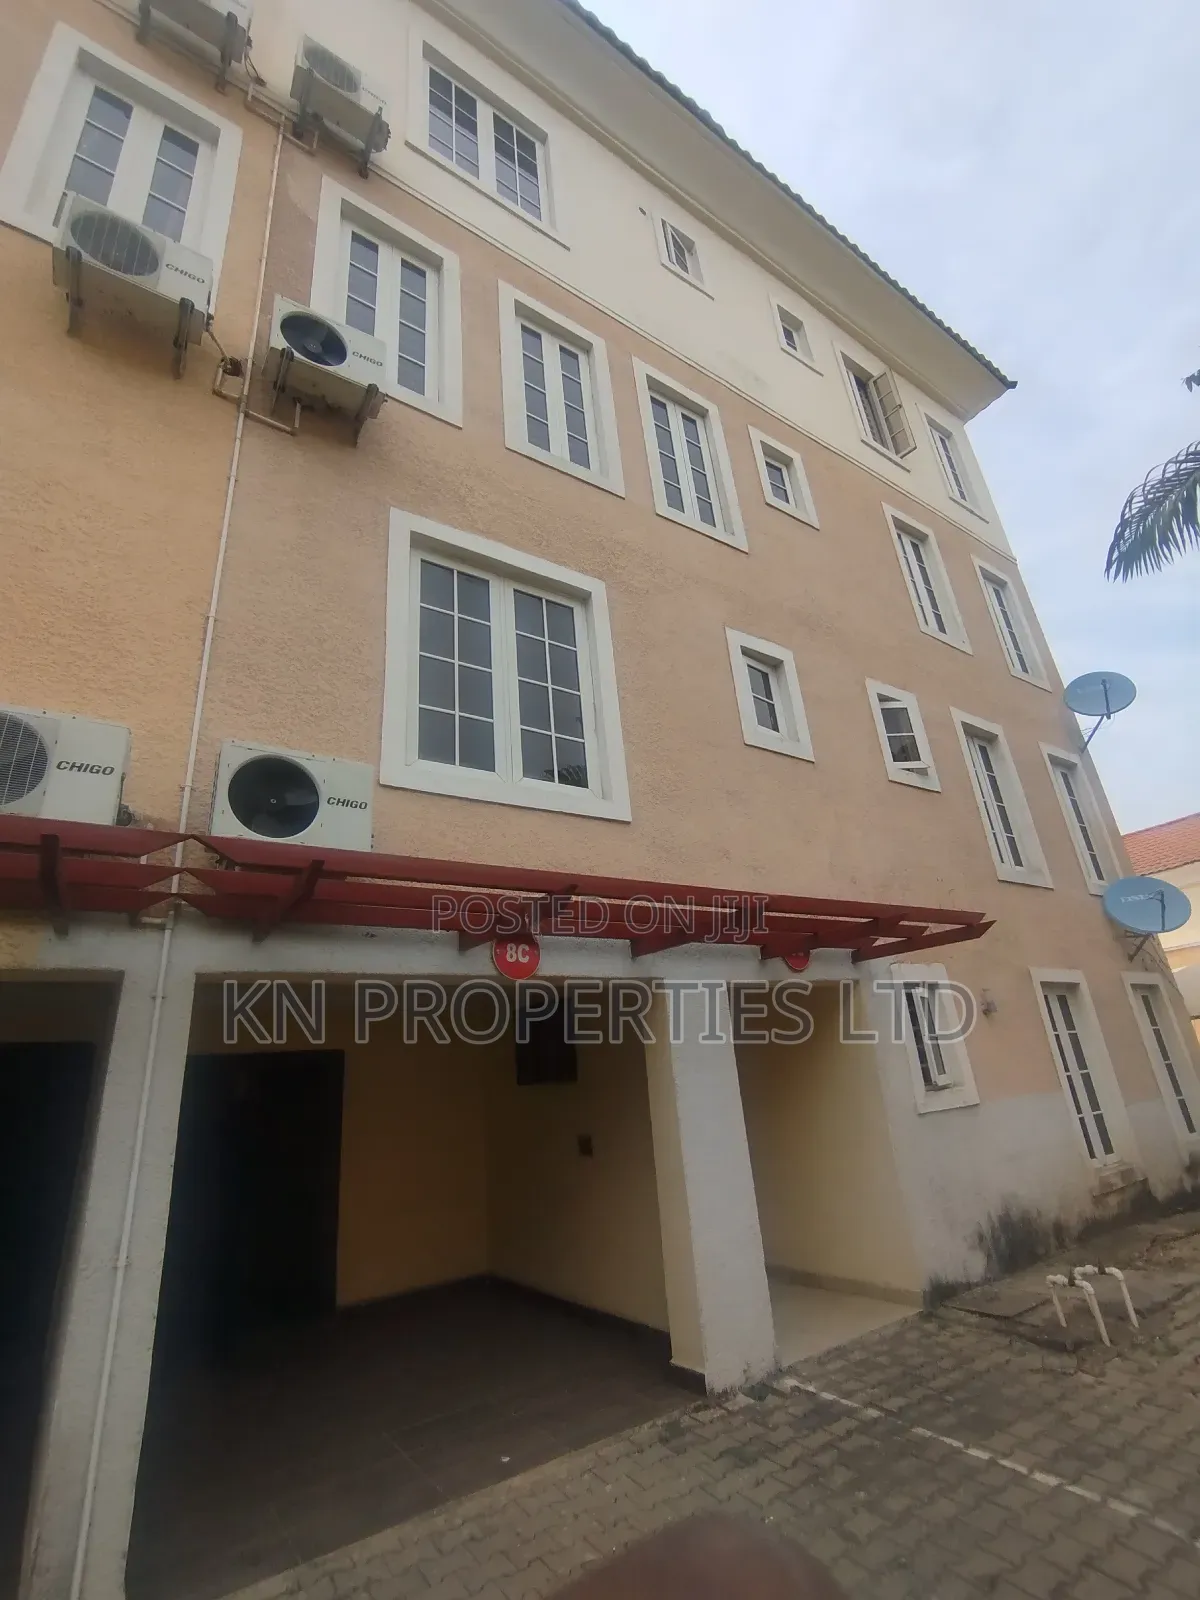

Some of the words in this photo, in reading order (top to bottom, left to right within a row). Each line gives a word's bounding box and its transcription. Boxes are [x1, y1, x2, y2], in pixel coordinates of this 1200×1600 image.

[165, 262, 206, 285] CHIGO
[351, 350, 384, 367] CHIGO
[56, 760, 116, 776] CHIGO
[326, 796, 369, 811] CHIGO
[506, 943, 530, 963] 8C
